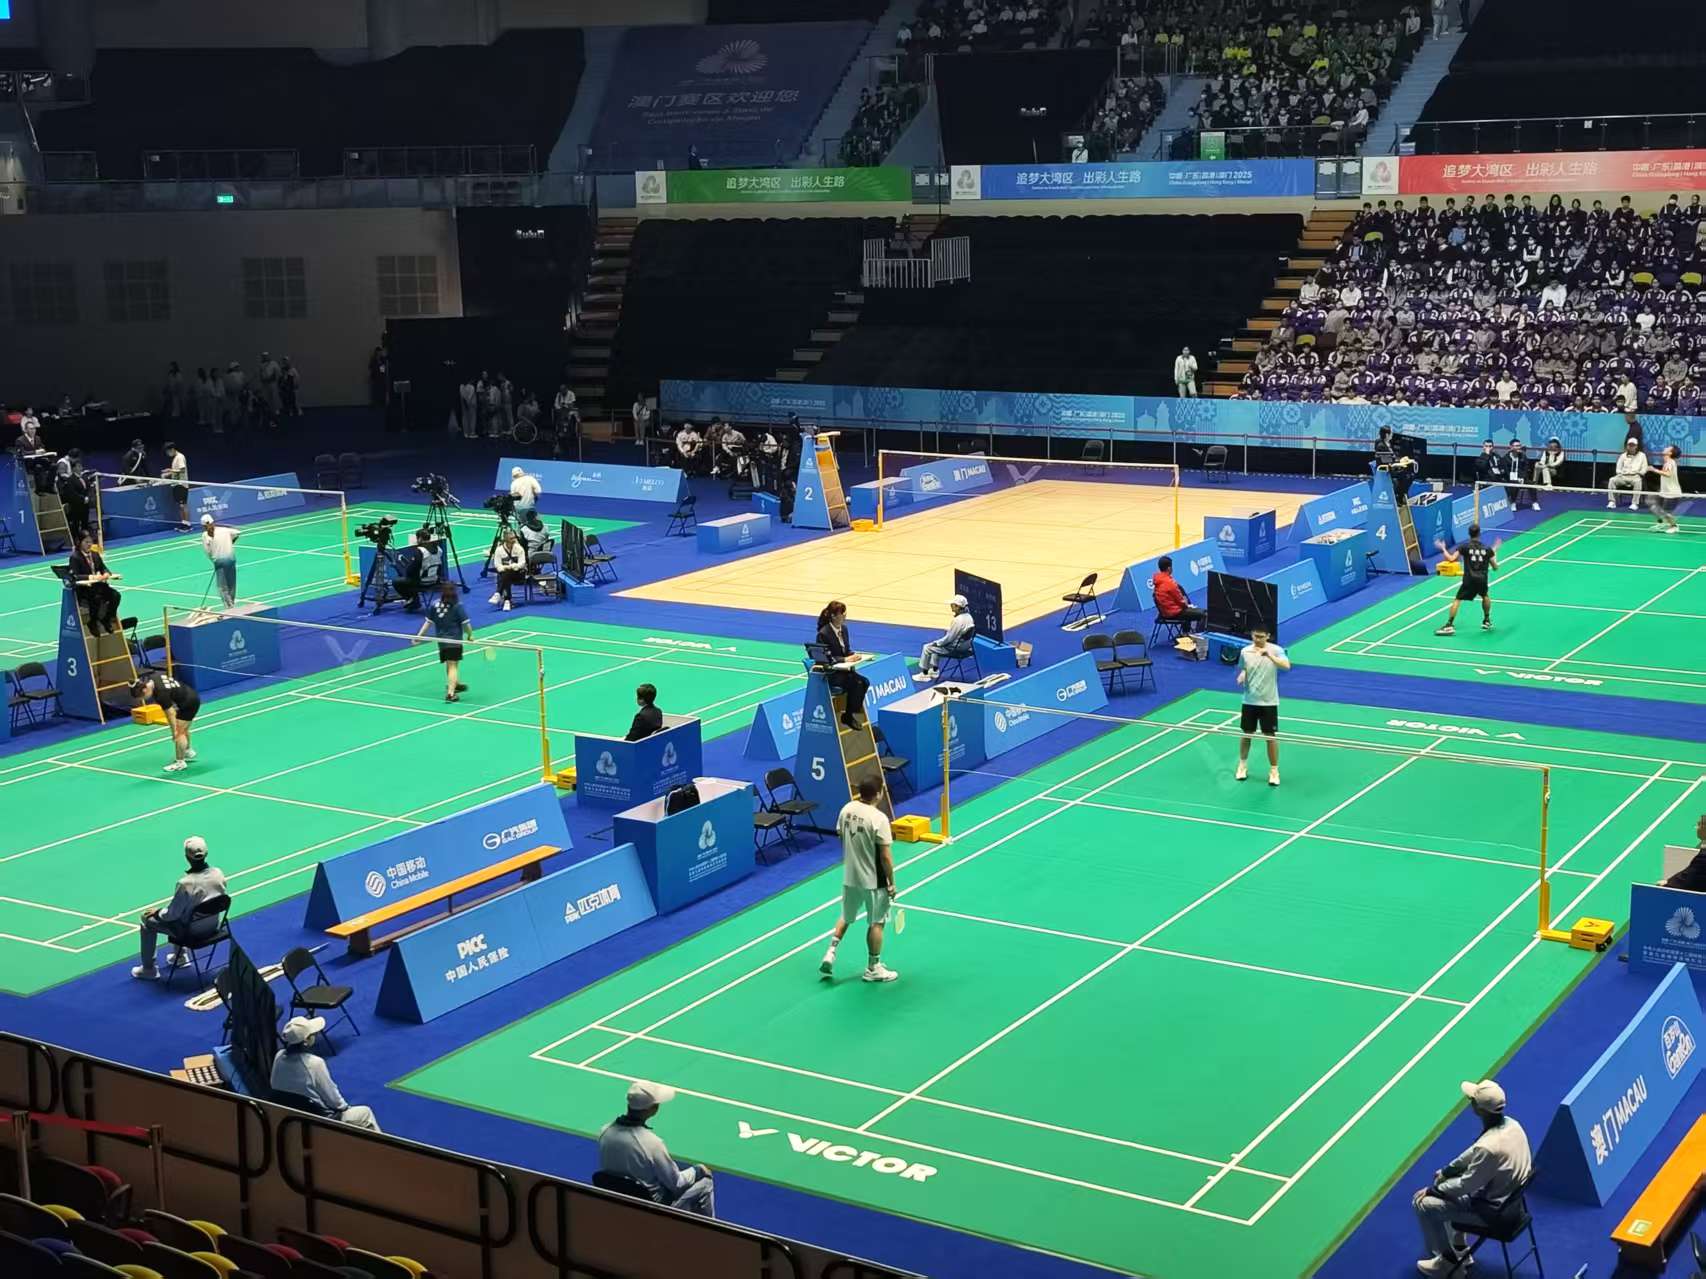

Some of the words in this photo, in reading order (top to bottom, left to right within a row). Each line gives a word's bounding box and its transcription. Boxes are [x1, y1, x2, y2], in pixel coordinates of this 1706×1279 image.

[1016, 172, 1073, 185] 追梦大湾区
[1083, 170, 1142, 184] 出彩人生路
[1442, 163, 1513, 178] 追梦大湾区
[1525, 161, 1600, 176] 出彩人生路
[727, 176, 781, 189] 追梦大湾区
[791, 175, 845, 188] 出彩人生路
[803, 488, 815, 501] 2
[19, 510, 26, 524] 1
[1375, 524, 1387, 540] 4
[68, 658, 78, 677] 3
[1504, 670, 1604, 686] VICTOR
[876, 675, 907, 700] MACAU
[1385, 719, 1491, 736] VICTOR
[811, 755, 825, 781] 5
[386, 857, 427, 879] 中国移动
[445, 947, 510, 983] 中国人民保险
[1590, 1108, 1619, 1166] 澳门
[1614, 1074, 1648, 1131] MACAU
[787, 1132, 938, 1183] VICTOR
